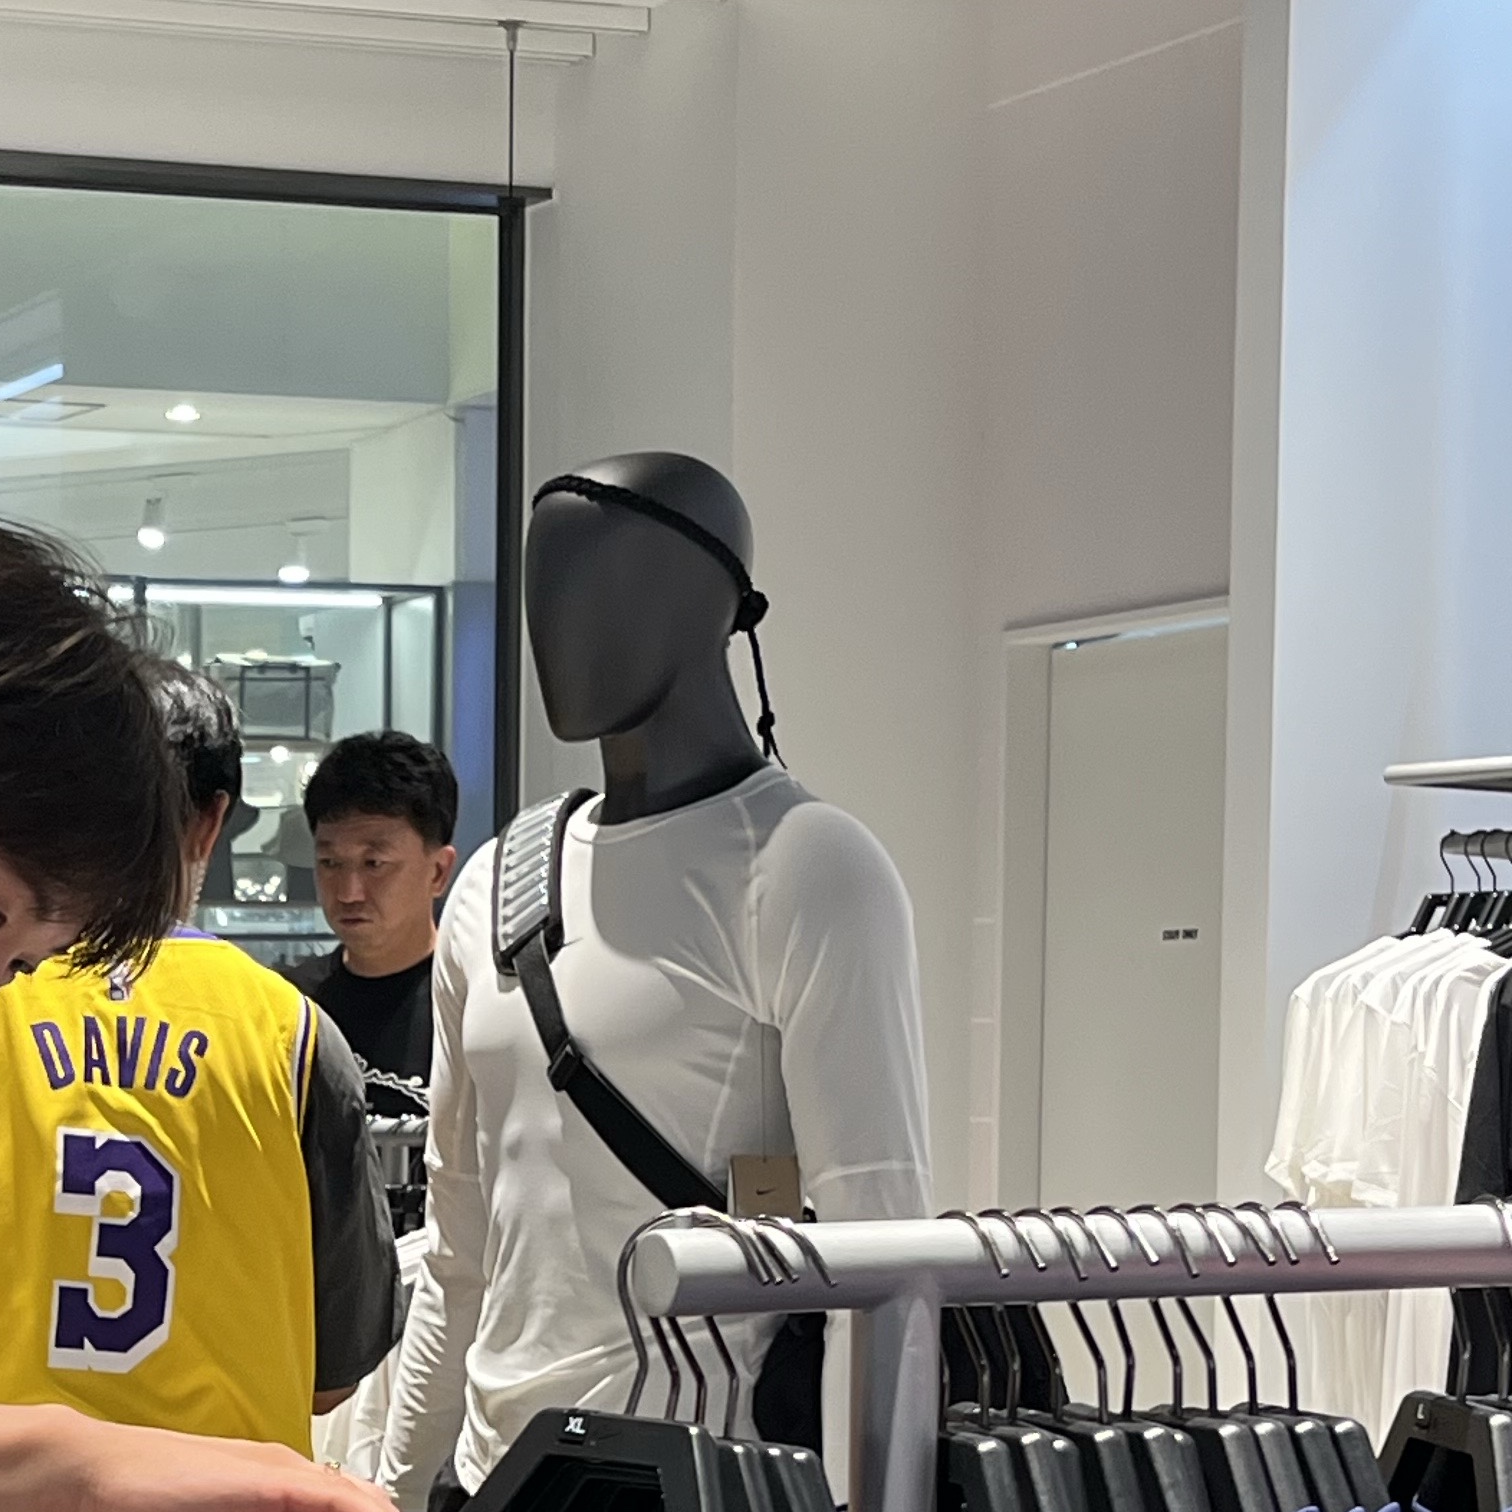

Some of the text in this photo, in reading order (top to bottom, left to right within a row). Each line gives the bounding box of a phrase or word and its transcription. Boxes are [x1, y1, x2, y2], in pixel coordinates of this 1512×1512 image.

[30, 1016, 208, 1098] DAVIS
[48, 1126, 180, 1374] 3
[564, 1416, 586, 1434] XL
